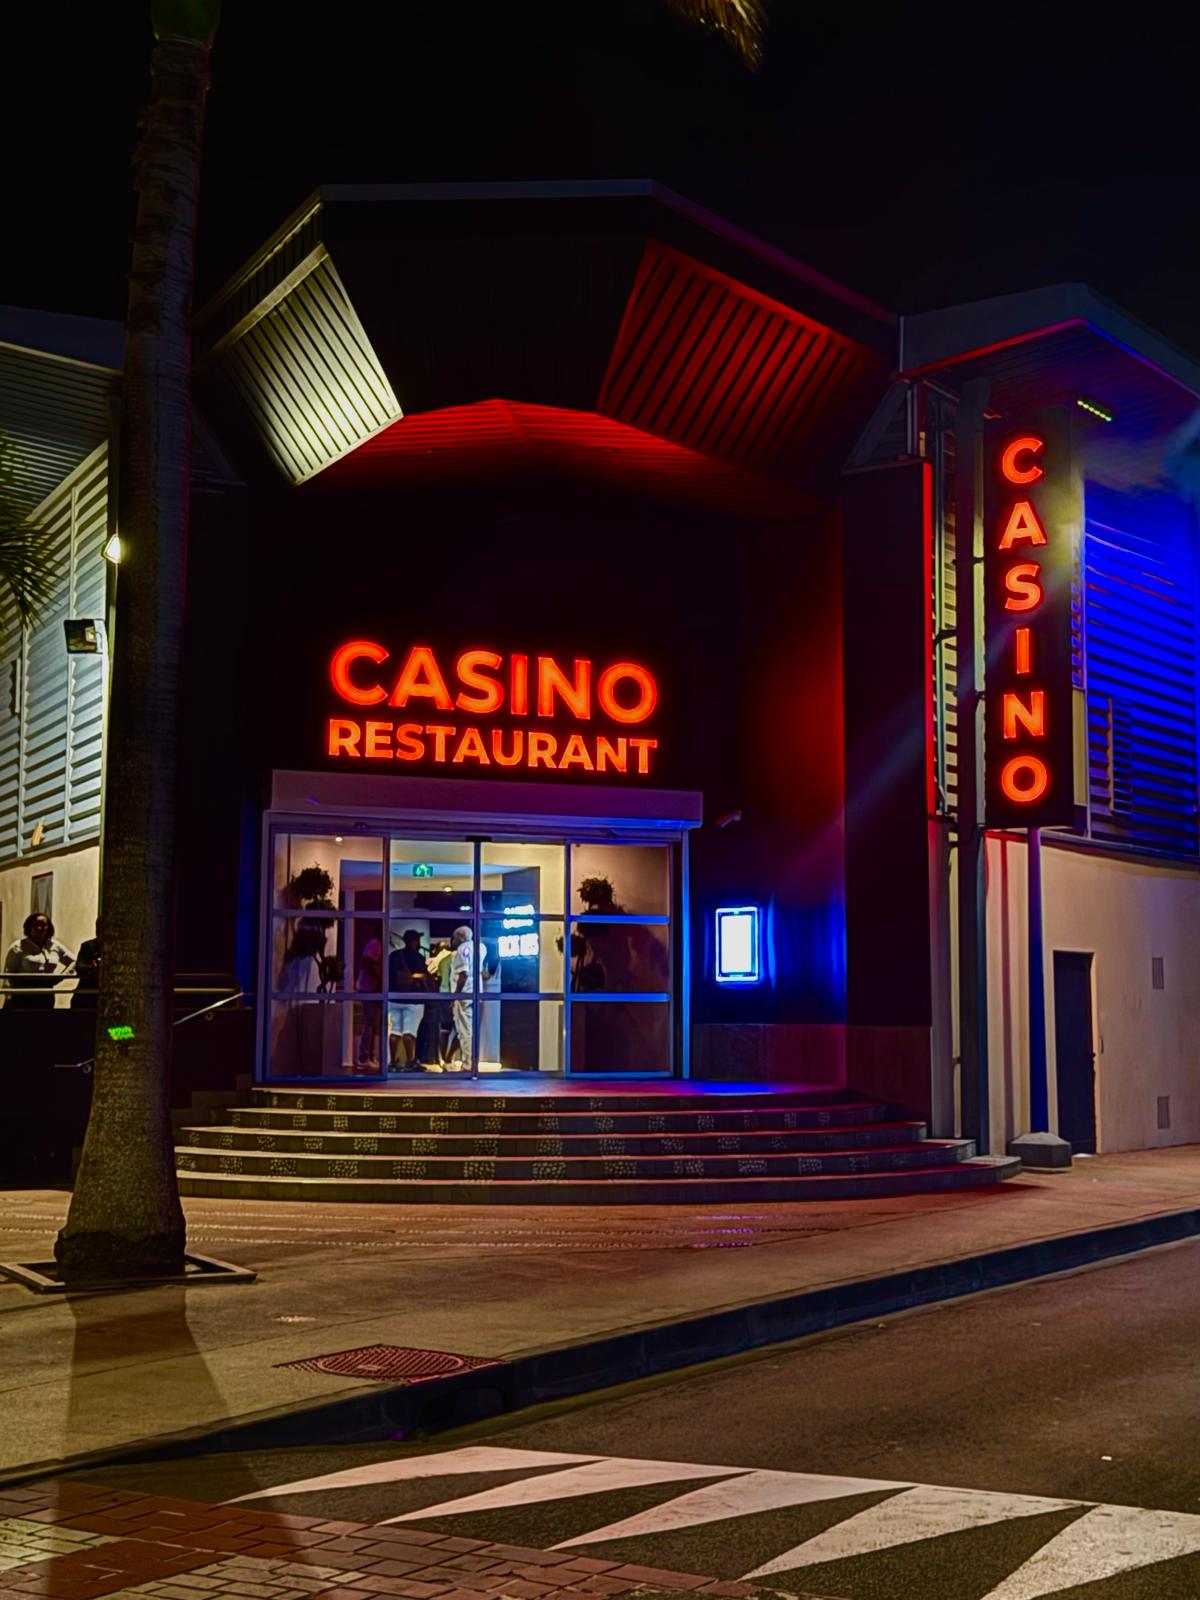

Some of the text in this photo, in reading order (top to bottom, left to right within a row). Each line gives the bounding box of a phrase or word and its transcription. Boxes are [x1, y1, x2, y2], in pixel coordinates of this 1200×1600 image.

[999, 437, 1048, 802] CASINO
[330, 640, 657, 723] CASINO
[328, 718, 658, 774] RESTAURANT
